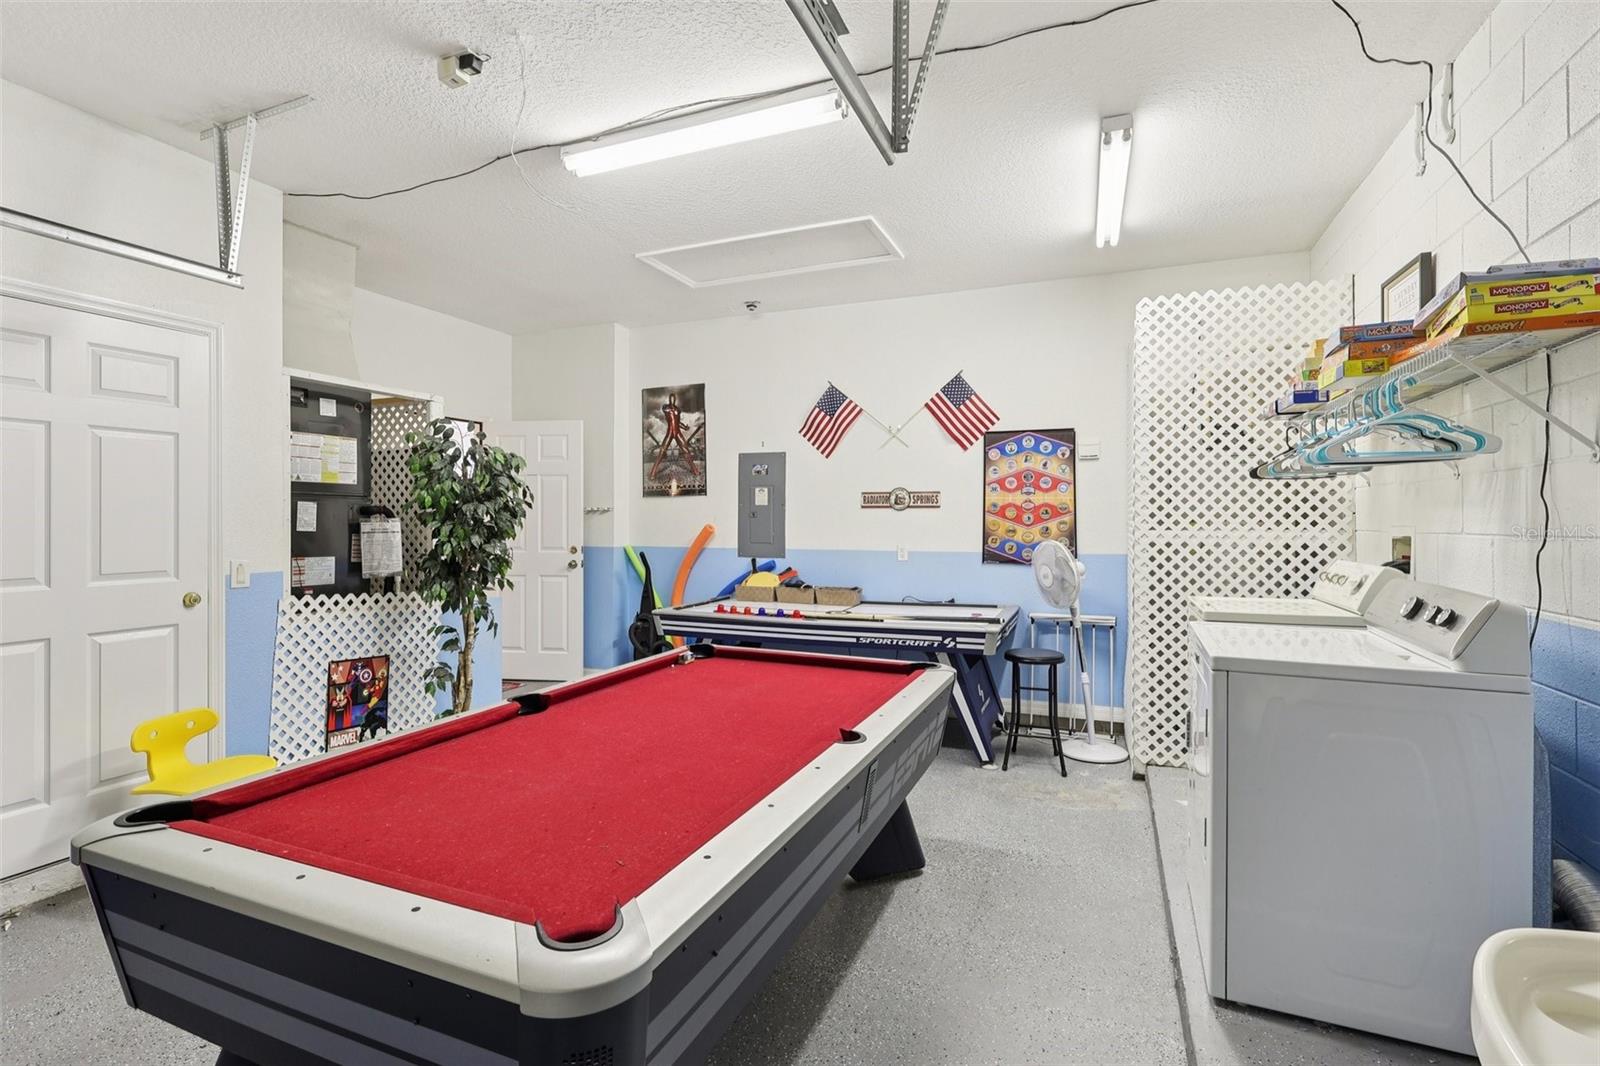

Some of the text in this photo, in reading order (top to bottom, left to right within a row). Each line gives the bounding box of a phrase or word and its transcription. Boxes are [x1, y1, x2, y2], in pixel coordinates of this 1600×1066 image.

[1492, 283, 1547, 295] MONOPOLY
[1497, 301, 1546, 313] MONOPOLY
[1367, 324, 1413, 337] MONOPOL
[1473, 320, 1525, 333] SORRY!
[862, 494, 939, 505] RADIATOR SPRINGS
[859, 638, 940, 648] SPORTCRAFT
[330, 732, 357, 747] MARVEL
